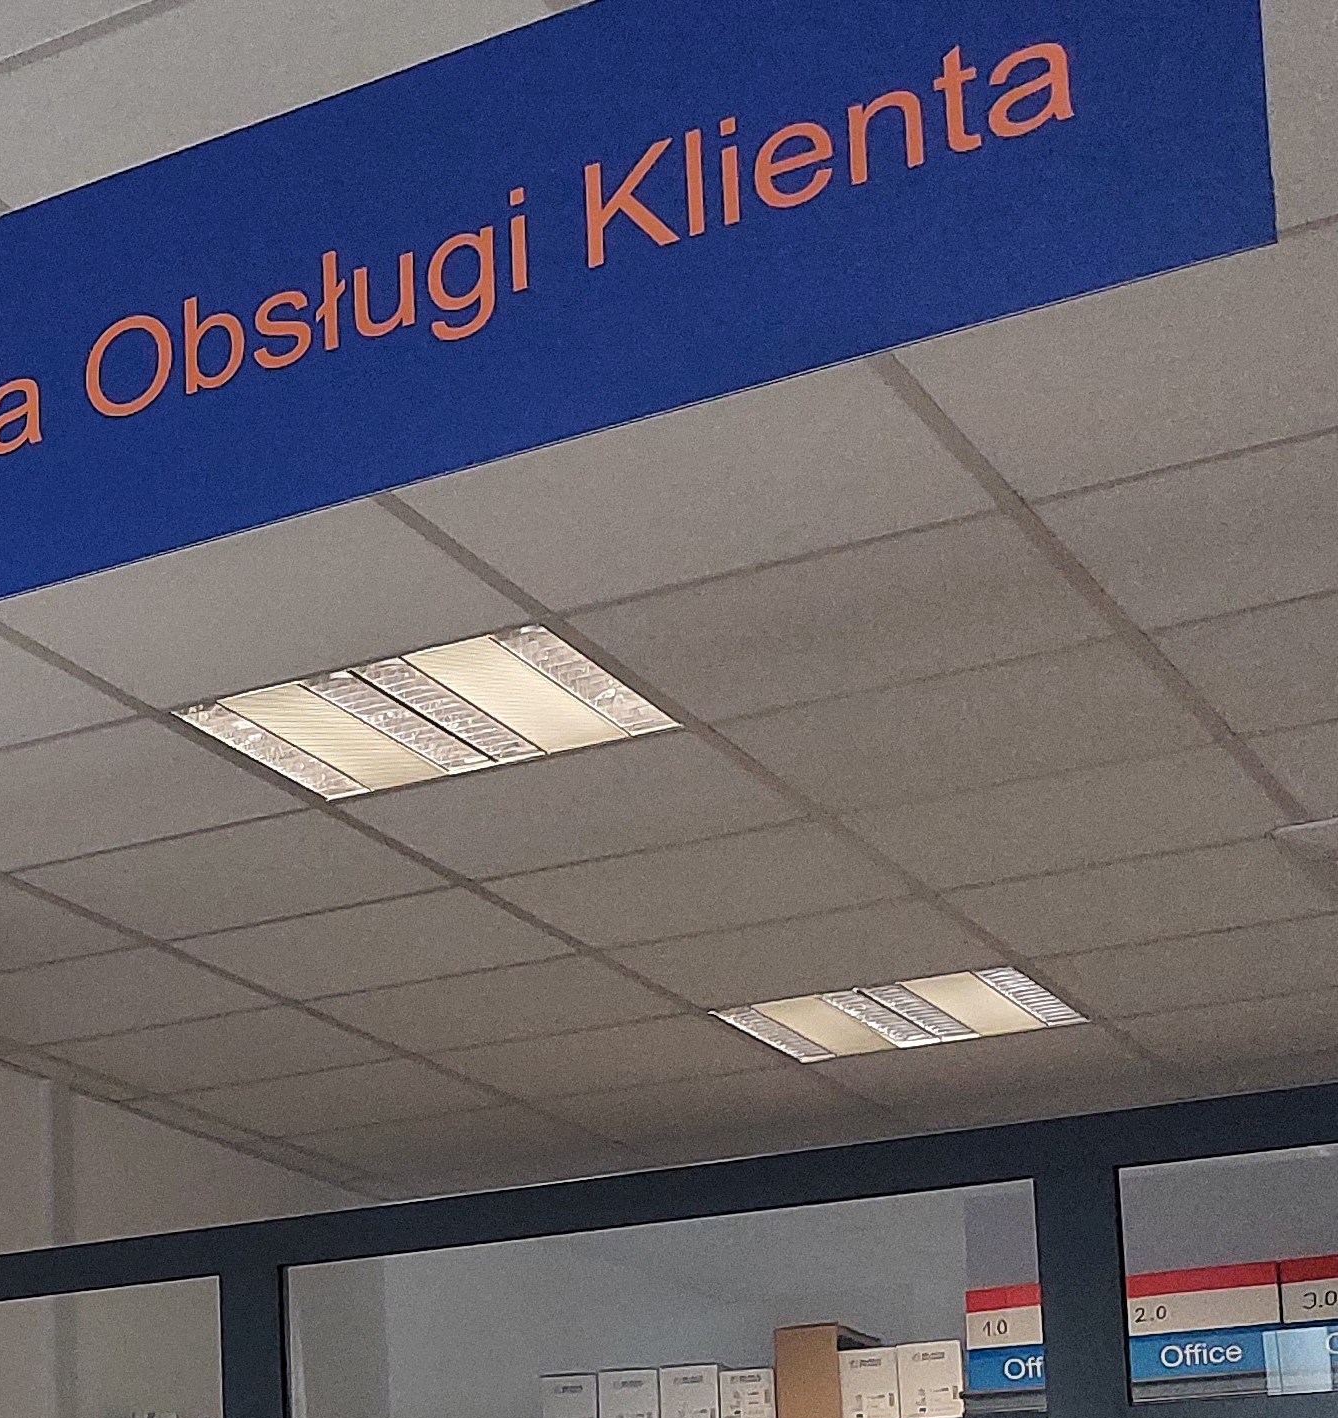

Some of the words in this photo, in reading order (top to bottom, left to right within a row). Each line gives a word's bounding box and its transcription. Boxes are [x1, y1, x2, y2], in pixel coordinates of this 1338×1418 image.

[85, 189, 529, 417] Obsługi
[584, 42, 1075, 267] Klienta
[1134, 1305, 1167, 1323] 2.0
[982, 1320, 1008, 1337] 1.0
[1161, 1344, 1243, 1368] Office
